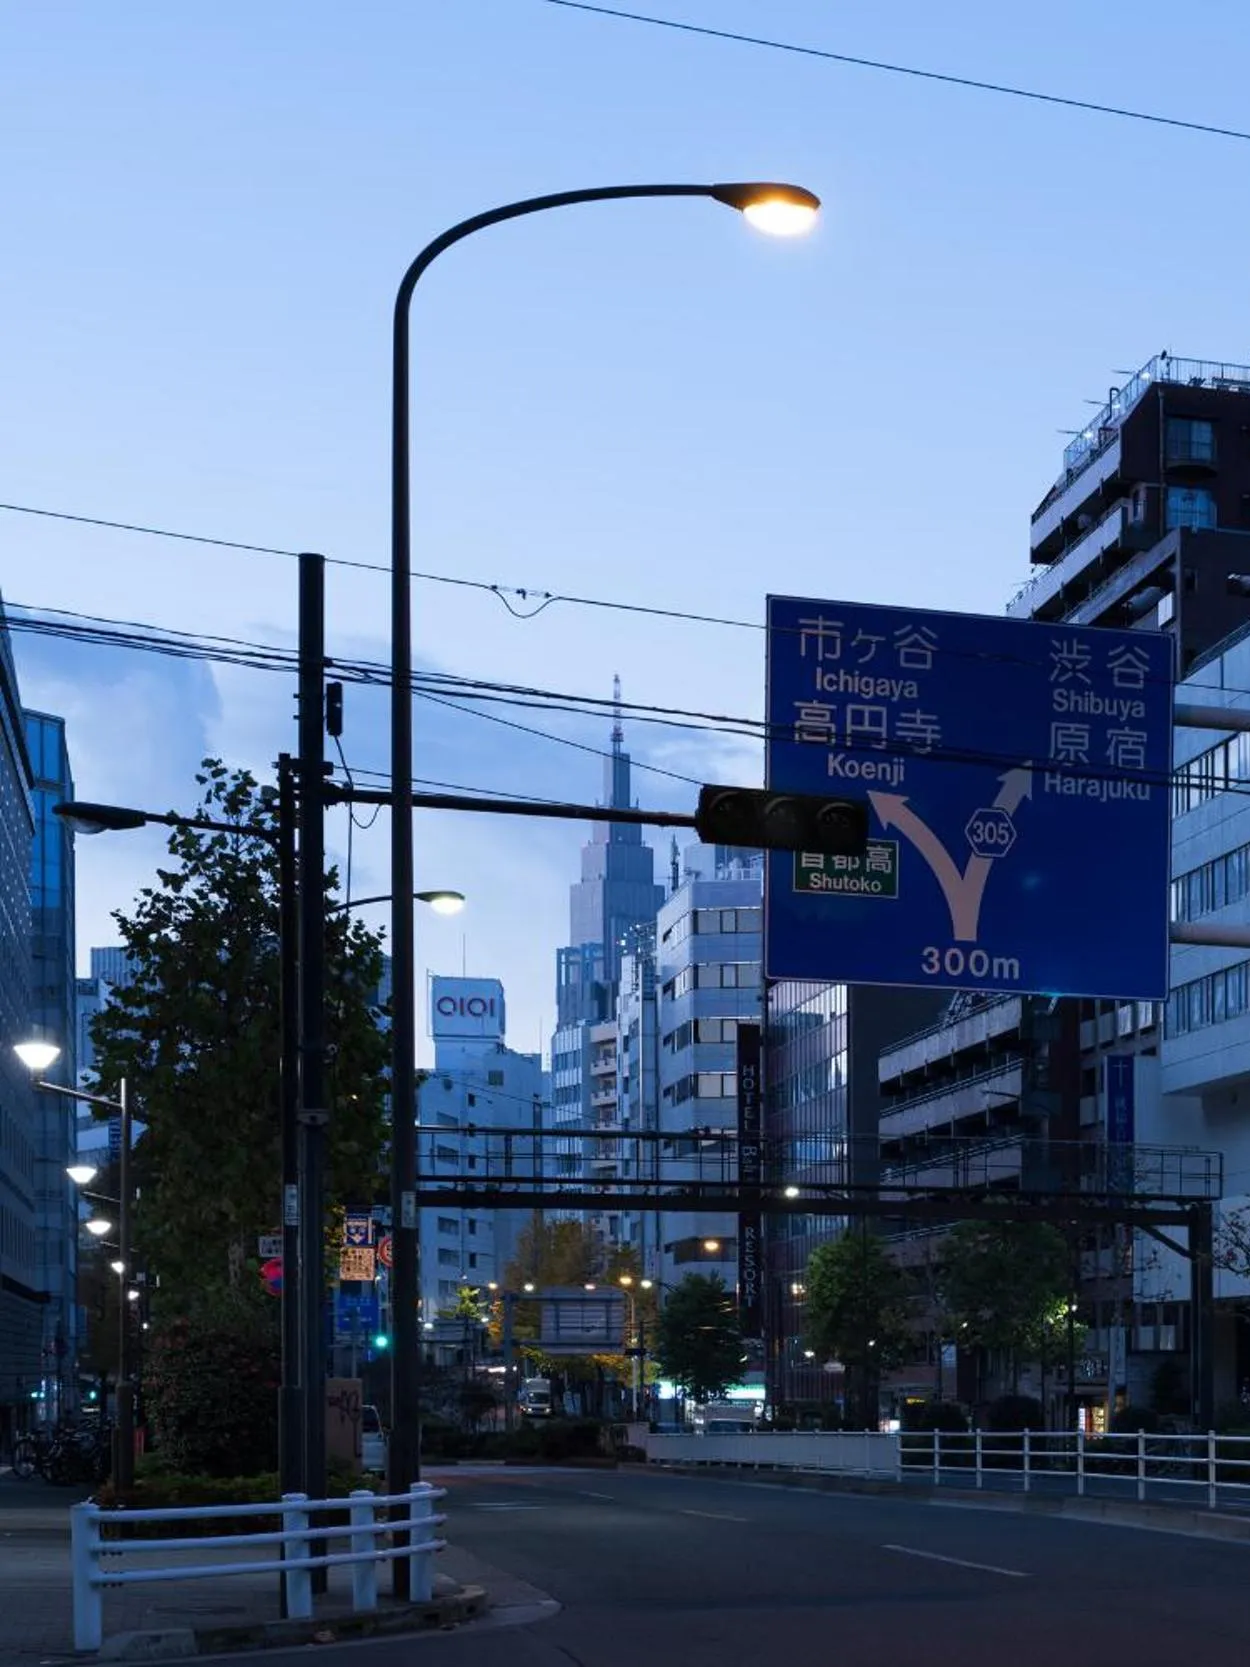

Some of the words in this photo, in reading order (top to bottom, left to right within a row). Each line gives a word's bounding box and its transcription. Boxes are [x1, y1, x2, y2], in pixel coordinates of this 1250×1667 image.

[1049, 638, 1150, 690] 渋谷
[815, 668, 918, 700] Ichigaya
[1052, 689, 1146, 721] Shibuya
[793, 700, 941, 755] 高円寺
[1049, 721, 1147, 770] 原宿
[828, 753, 905, 786] Koenji
[1044, 771, 1150, 801] Harajuku
[972, 819, 1010, 847] 305
[809, 873, 882, 893] Shutoko
[921, 947, 1020, 980] 300m
[742, 1064, 756, 1133] HOTEL
